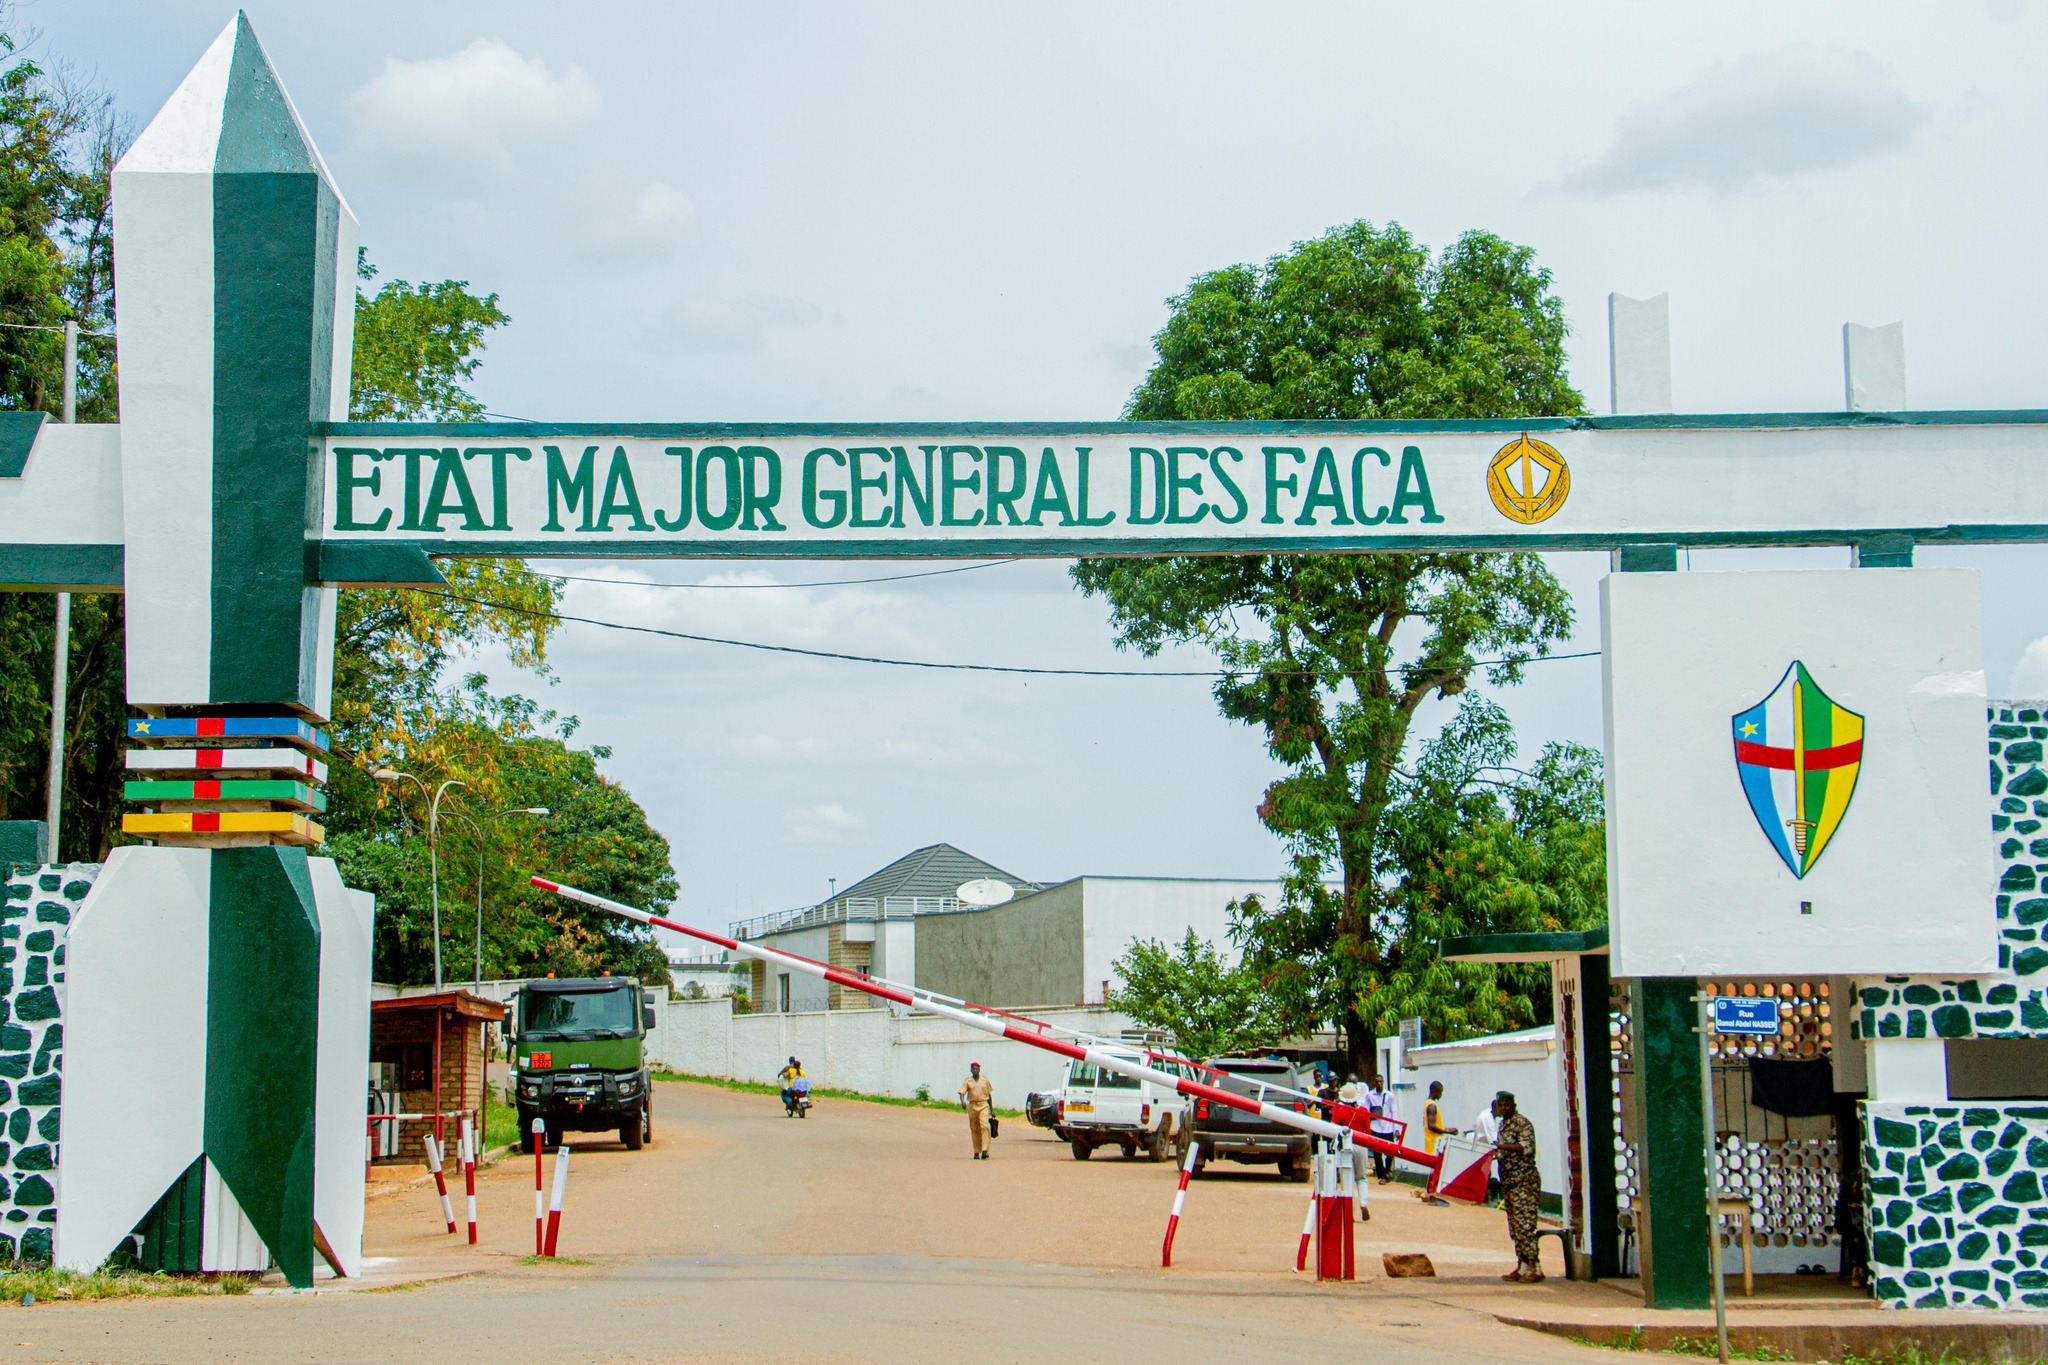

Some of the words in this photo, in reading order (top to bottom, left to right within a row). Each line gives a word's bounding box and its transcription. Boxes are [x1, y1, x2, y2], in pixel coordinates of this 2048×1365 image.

[332, 446, 532, 532] ETAT
[541, 445, 786, 532] MAJOR
[802, 445, 1117, 529] GENERAL
[1127, 446, 1249, 526] DES
[1261, 446, 1445, 525] FACA
[1738, 1009, 1754, 1018] Rue
[1752, 1020, 1776, 1029] NASSER
[533, 1060, 550, 1068] 1202
